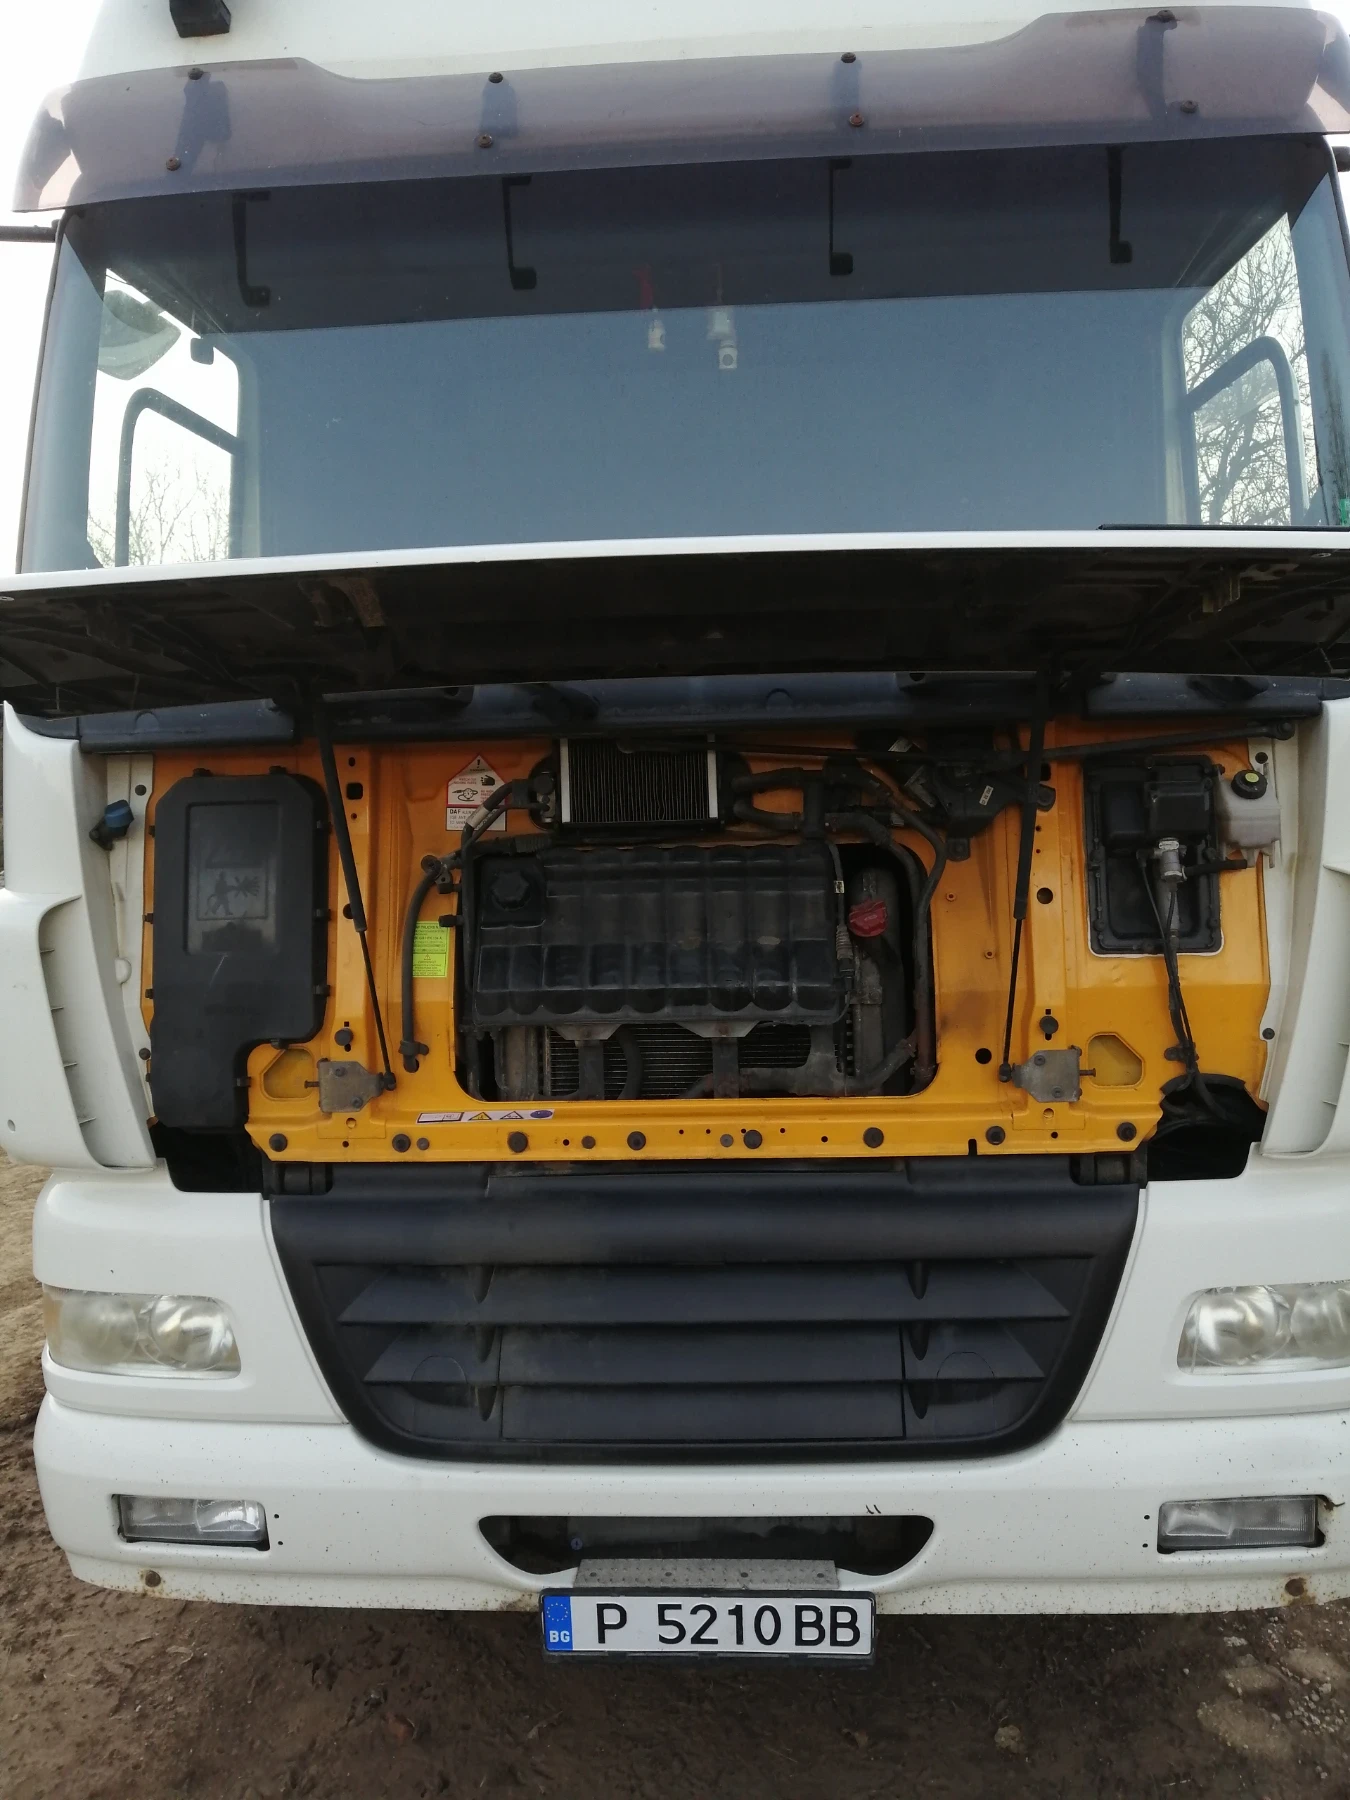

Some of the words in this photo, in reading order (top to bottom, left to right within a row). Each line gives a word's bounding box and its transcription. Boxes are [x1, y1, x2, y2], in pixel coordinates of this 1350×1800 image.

[549, 1630, 571, 1643] BG
[596, 1602, 627, 1644] P
[657, 1603, 782, 1646] 5210
[794, 1604, 861, 1647] BB
